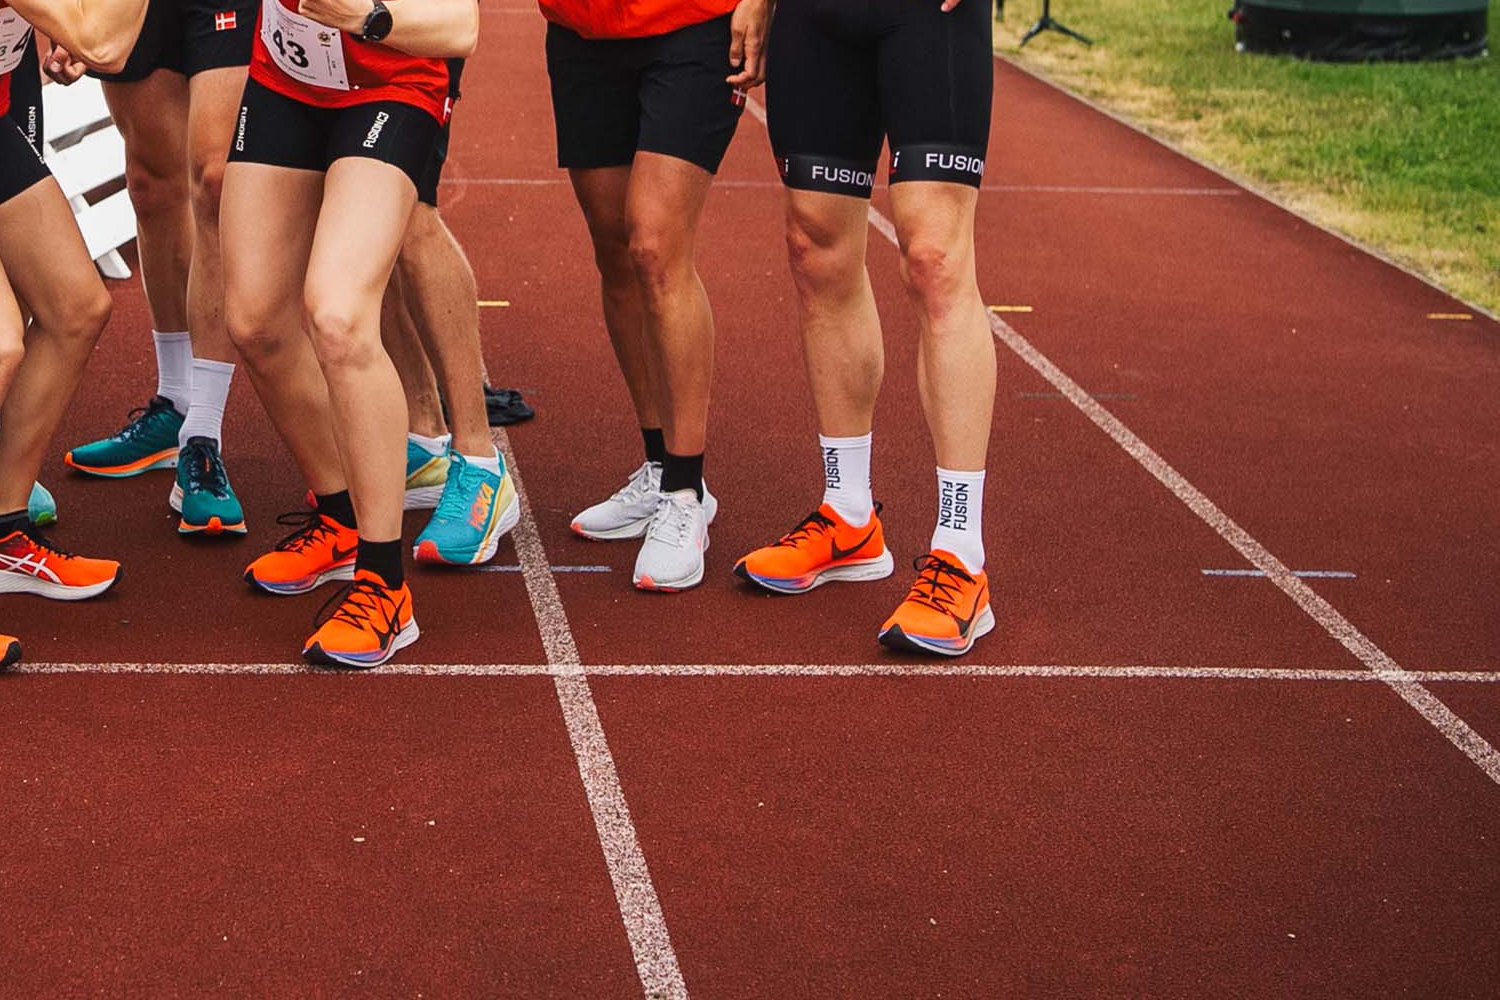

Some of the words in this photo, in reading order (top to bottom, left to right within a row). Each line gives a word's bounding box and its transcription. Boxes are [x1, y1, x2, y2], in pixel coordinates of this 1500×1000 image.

[272, 29, 310, 69] 43
[811, 165, 875, 187] FUSION
[925, 152, 985, 177] FUSION
[825, 447, 841, 490] FUSION
[467, 482, 495, 532] HOKA
[939, 480, 954, 529] FUSION
[953, 482, 970, 531] FUSION
